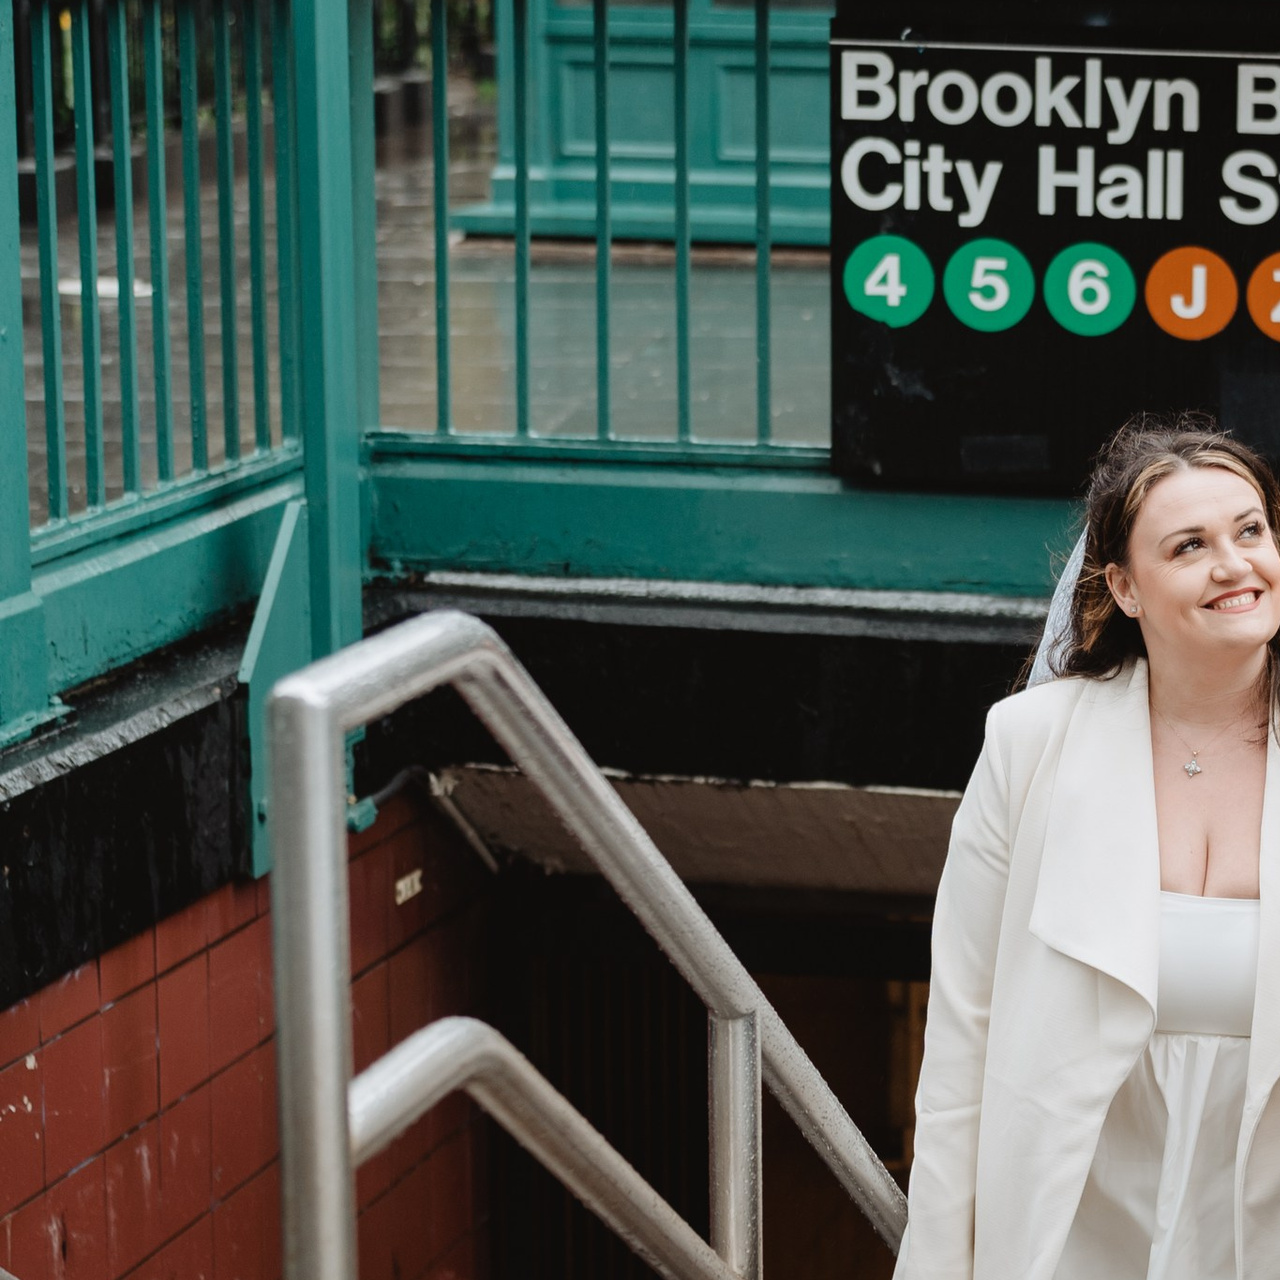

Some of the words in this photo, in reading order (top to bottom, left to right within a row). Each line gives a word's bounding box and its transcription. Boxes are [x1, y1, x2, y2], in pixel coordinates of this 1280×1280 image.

[841, 50, 1200, 143] Brooklyn
[841, 137, 1003, 228] City
[1037, 145, 1184, 221] Hall
[864, 253, 907, 307] 4
[968, 257, 1010, 312] 5
[1067, 259, 1111, 315] 6
[1170, 264, 1207, 319] J
